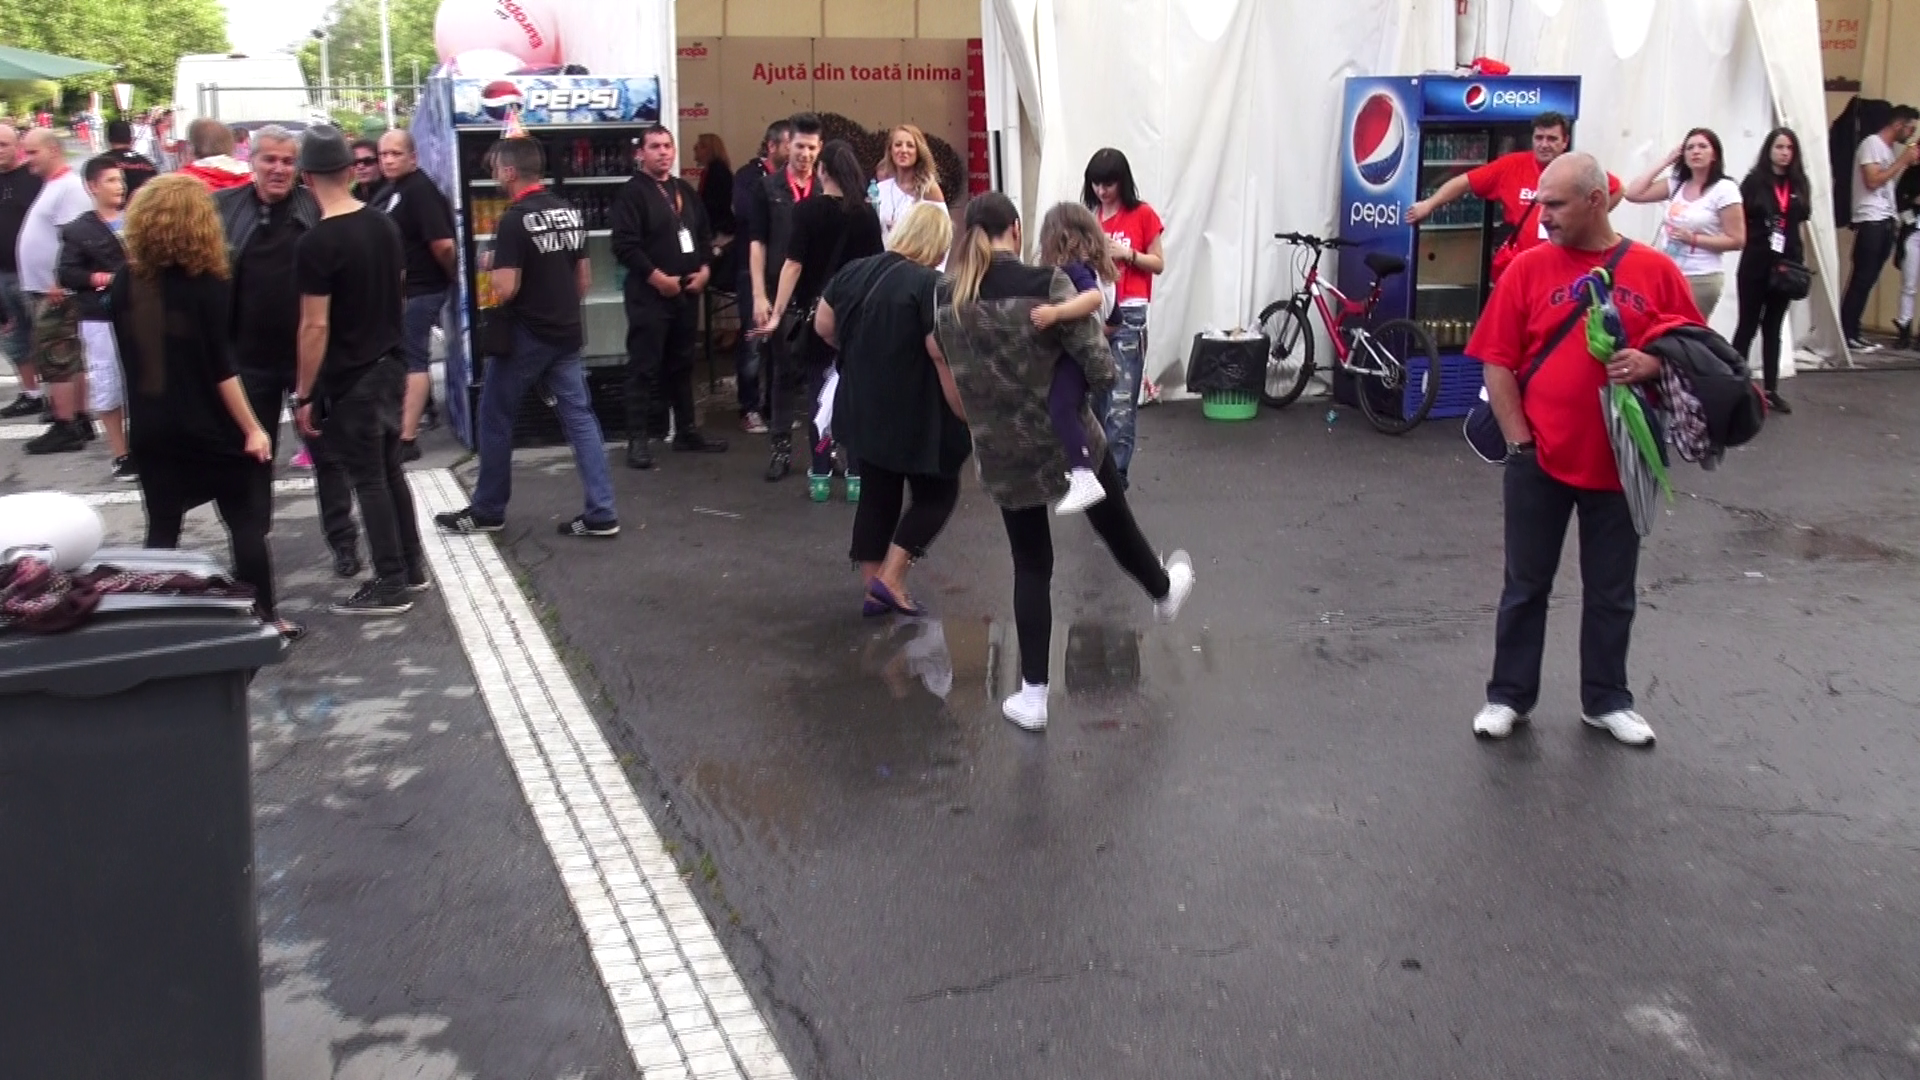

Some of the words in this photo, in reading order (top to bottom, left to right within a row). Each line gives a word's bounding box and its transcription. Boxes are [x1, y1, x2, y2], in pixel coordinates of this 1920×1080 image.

[504, 0, 543, 49] Europ
[752, 62, 807, 85] Ajută
[812, 62, 845, 81] din
[850, 63, 901, 81] toată
[906, 63, 961, 81] inima
[528, 89, 619, 111] PEPSI
[1492, 87, 1541, 108] pepsi
[1350, 200, 1400, 229] pepsi
